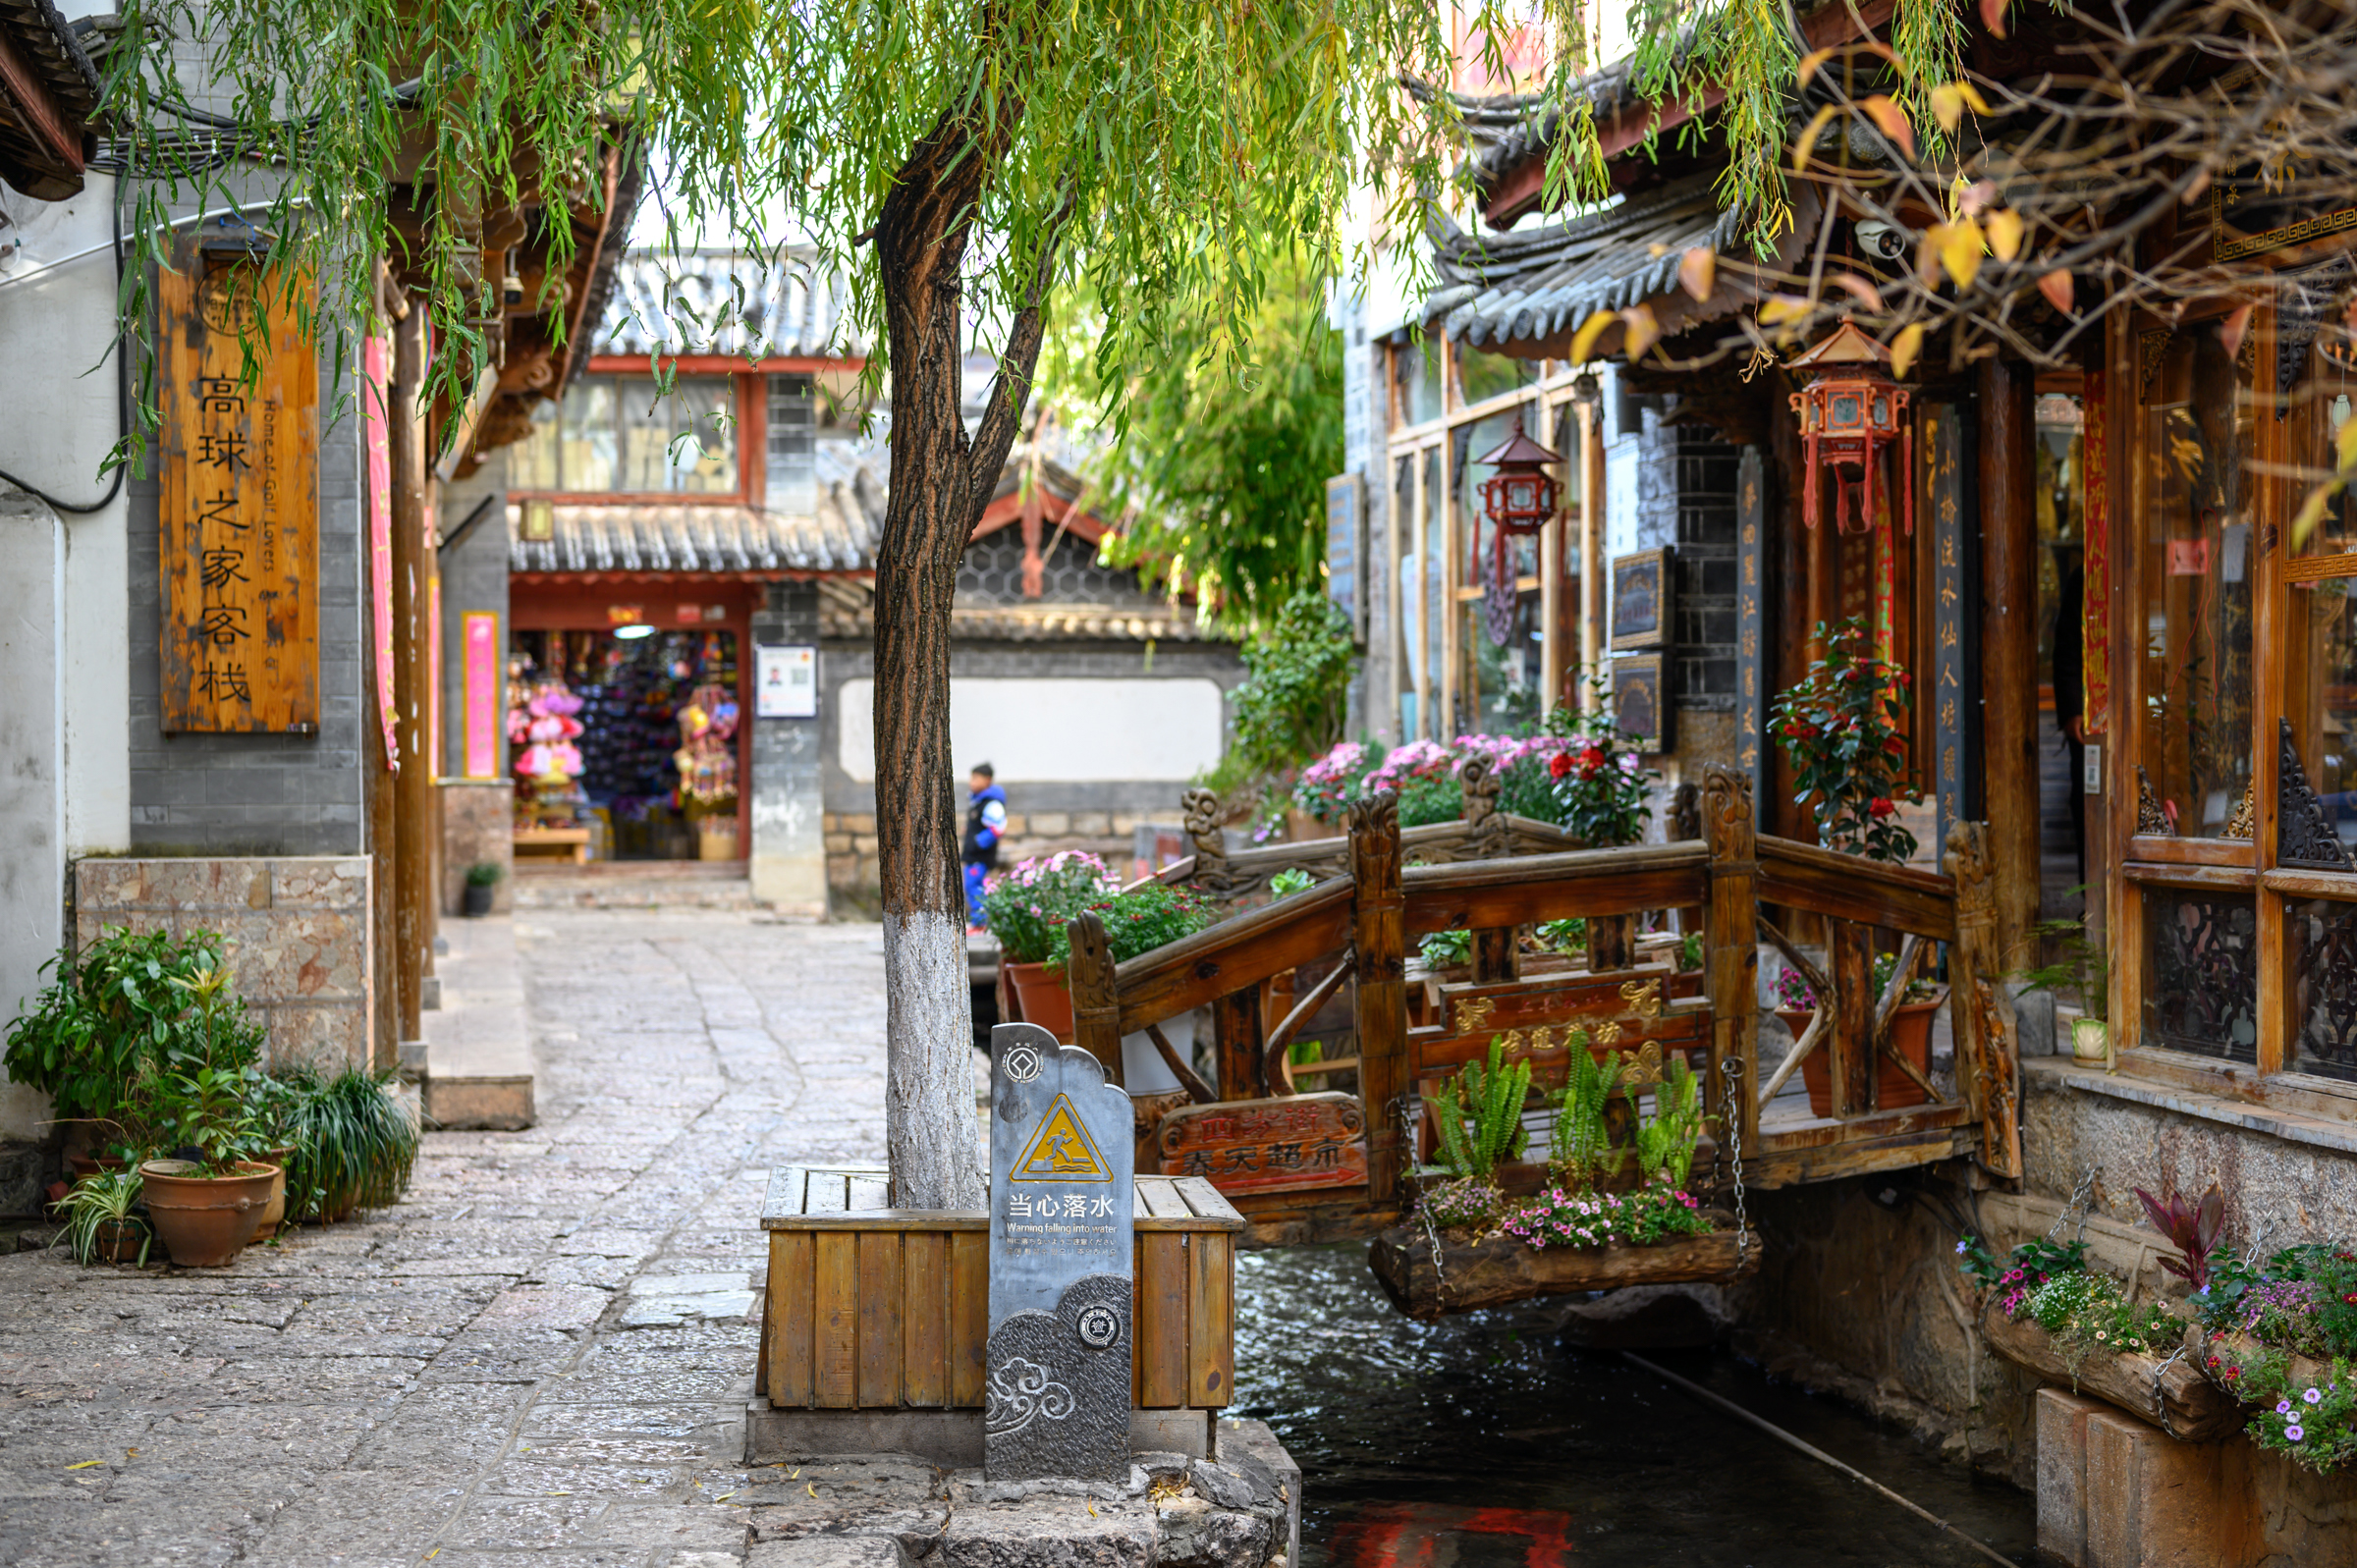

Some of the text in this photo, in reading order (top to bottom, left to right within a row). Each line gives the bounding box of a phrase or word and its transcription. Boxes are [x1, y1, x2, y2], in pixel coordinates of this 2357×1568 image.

[263, 400, 276, 573] Home of Golf Lovers
[197, 370, 251, 703] 高球之家客栈
[1200, 1106, 1321, 1143] 四方街
[1180, 1136, 1345, 1177] 春天超市
[1010, 1193, 1115, 1217] 当心落水
[1006, 1222, 1118, 1235] Warning falling into water
